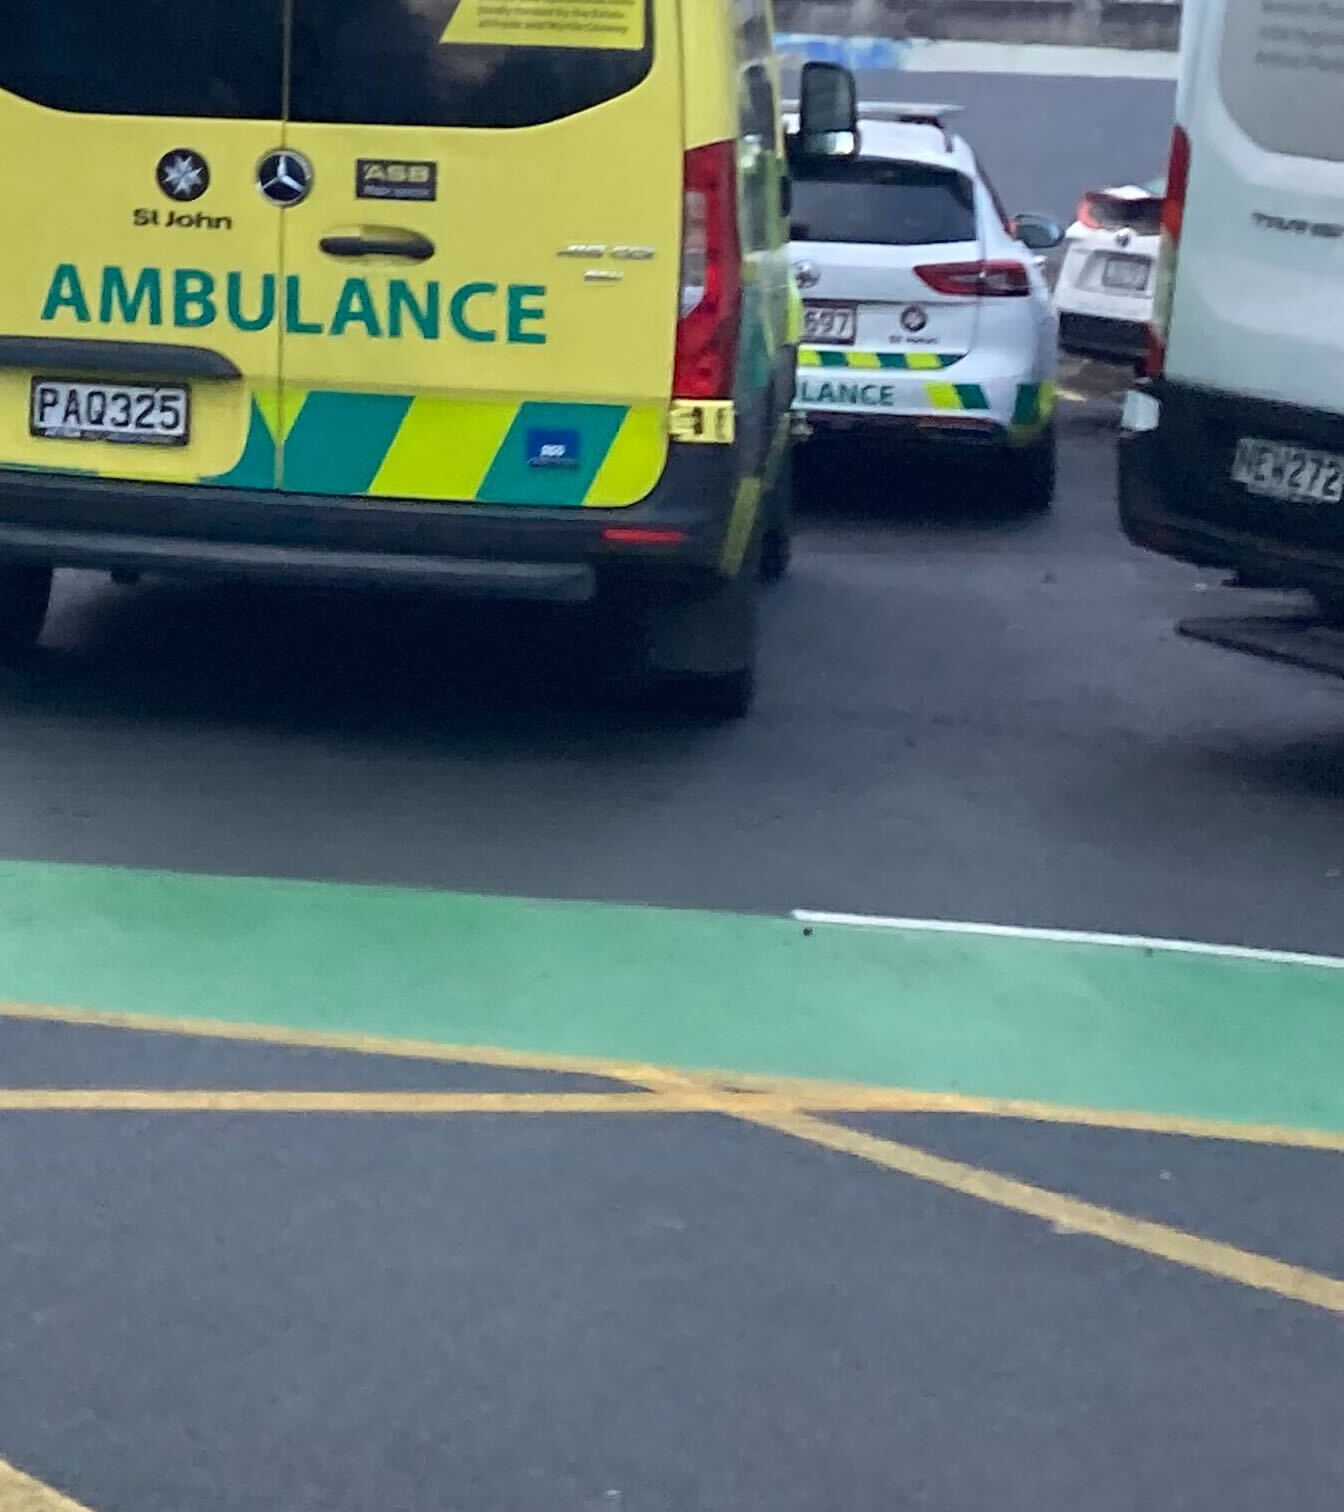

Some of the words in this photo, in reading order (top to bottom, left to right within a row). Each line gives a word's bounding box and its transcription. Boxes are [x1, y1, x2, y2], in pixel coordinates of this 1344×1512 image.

[132, 208, 162, 227] St
[165, 208, 232, 231] John
[40, 263, 547, 345] AMBULANCE
[36, 382, 187, 434] PAQ325
[801, 381, 896, 407] LANCE
